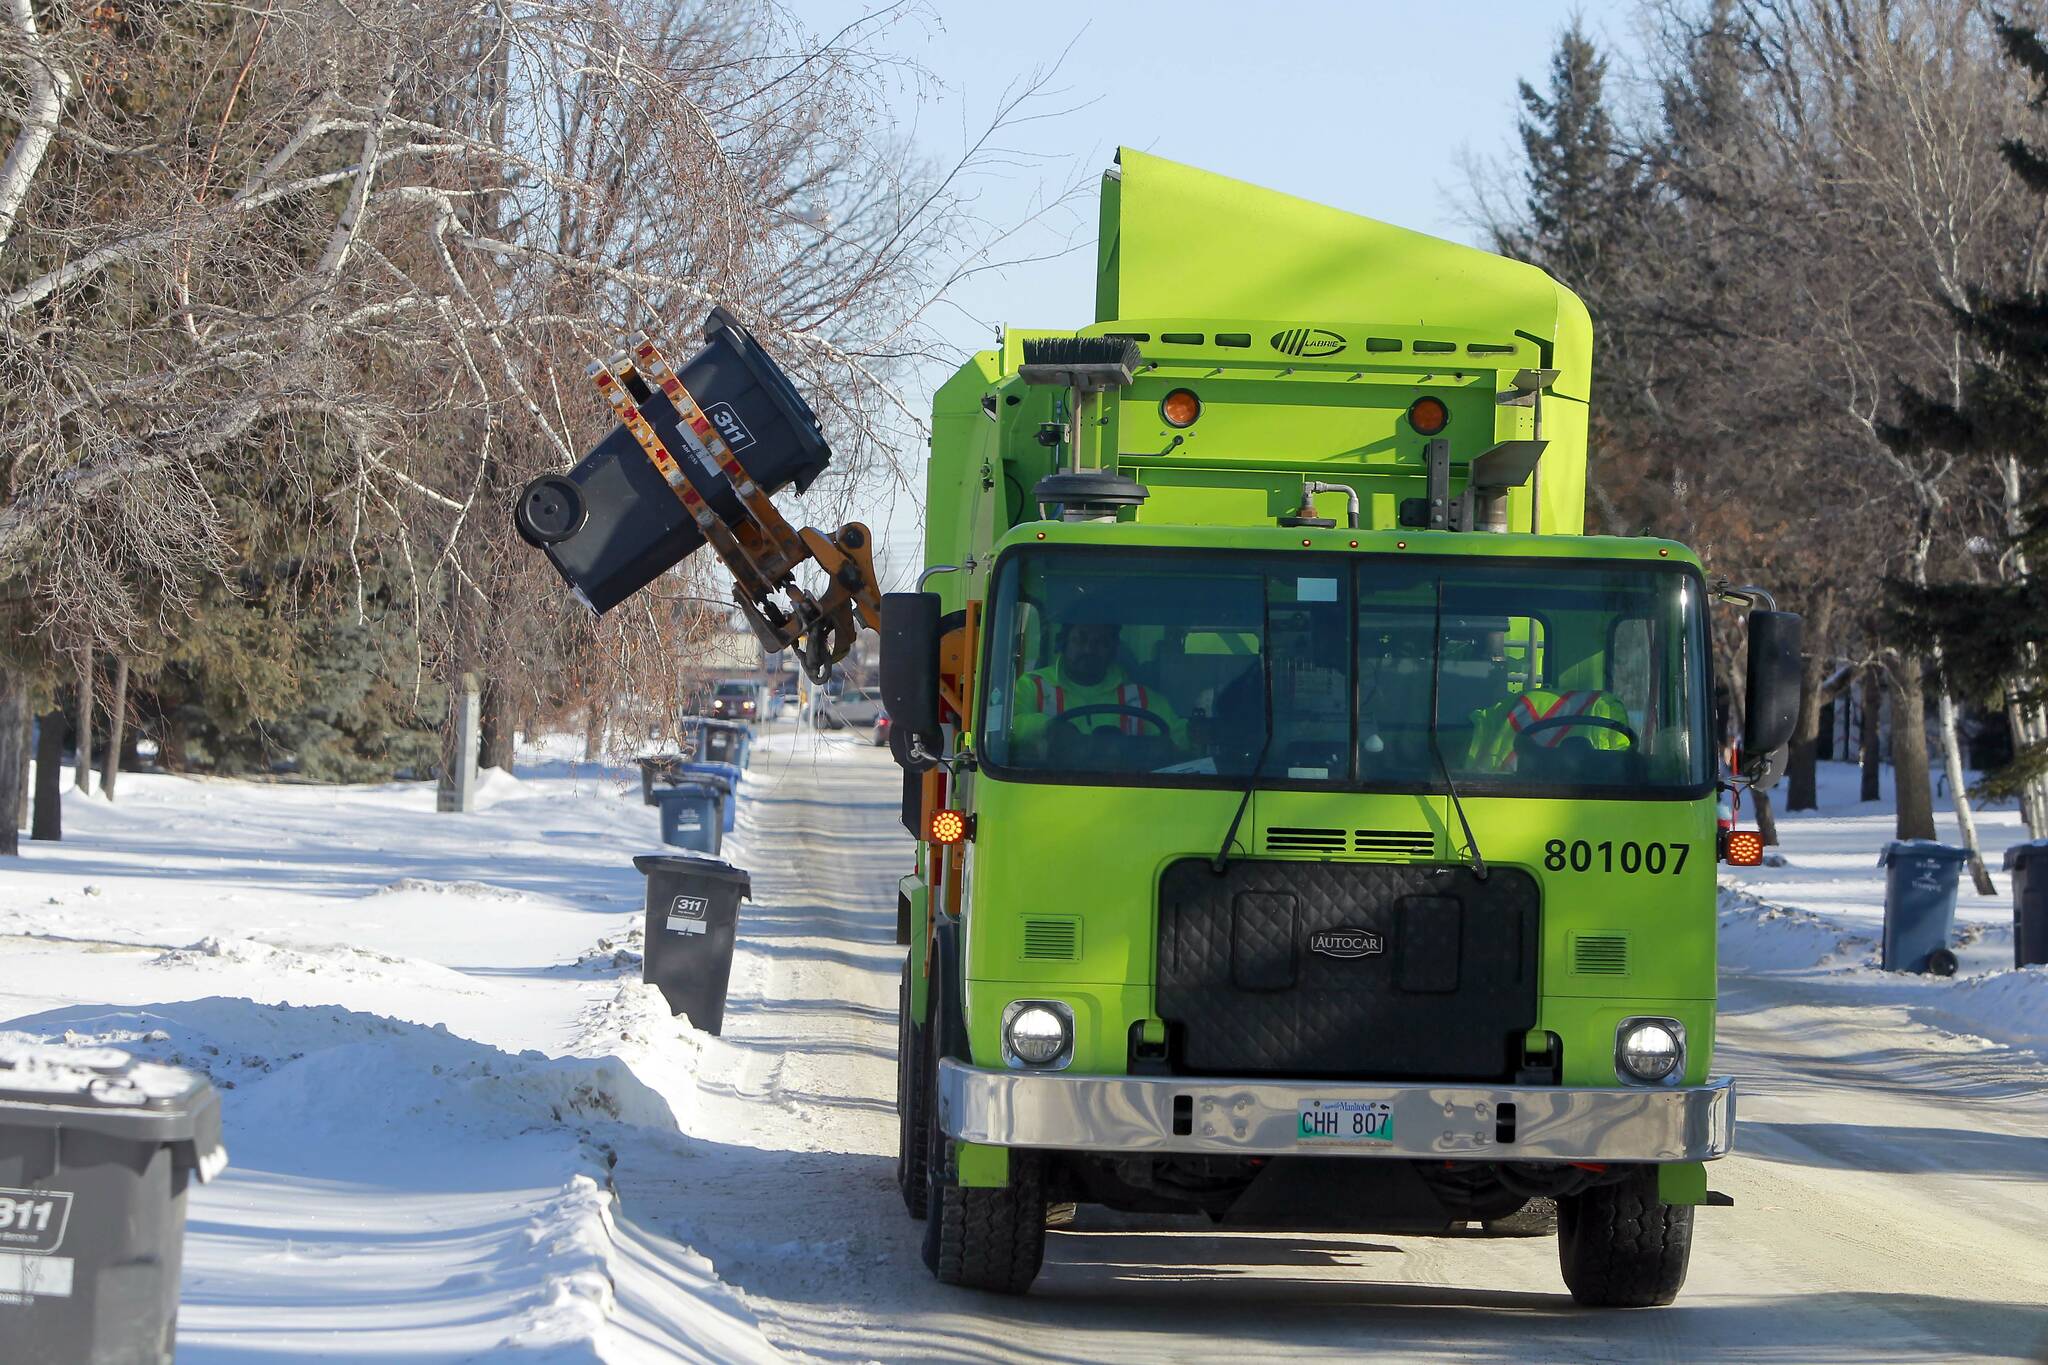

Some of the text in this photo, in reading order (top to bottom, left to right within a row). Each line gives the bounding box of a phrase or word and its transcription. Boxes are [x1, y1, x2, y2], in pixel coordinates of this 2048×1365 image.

[1304, 340, 1339, 348] LABRIE
[713, 411, 746, 443] 311
[1544, 838, 1690, 875] 801007
[677, 899, 702, 911] 311
[1315, 935, 1380, 950] AUTOCAR
[1339, 1101, 1371, 1112] Manitoba
[1302, 1112, 1389, 1135] CHH 807
